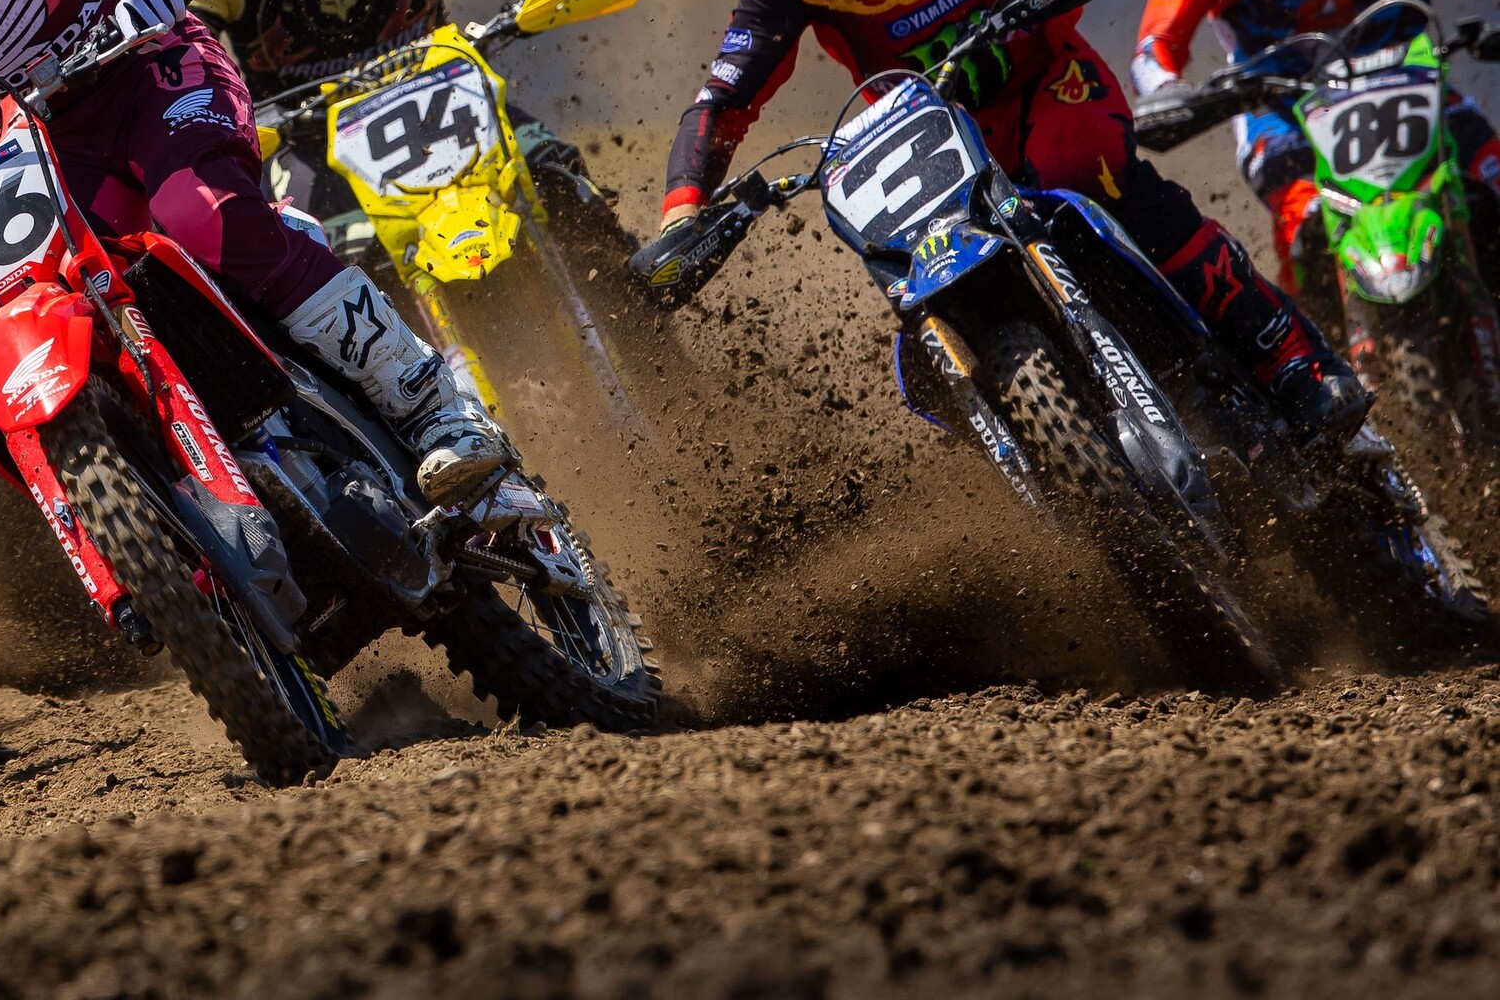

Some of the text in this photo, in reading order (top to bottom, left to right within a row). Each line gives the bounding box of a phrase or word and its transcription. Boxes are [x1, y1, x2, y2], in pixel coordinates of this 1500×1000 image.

[366, 87, 480, 197] 94
[841, 109, 965, 247] 3
[1333, 94, 1430, 176] 86
[5, 364, 70, 407] HONDA
[243, 407, 274, 431] Twin Air
[1090, 330, 1166, 424] DUNLOP
[175, 383, 253, 497] DUNLOP
[29, 482, 98, 595] DUNLOP
